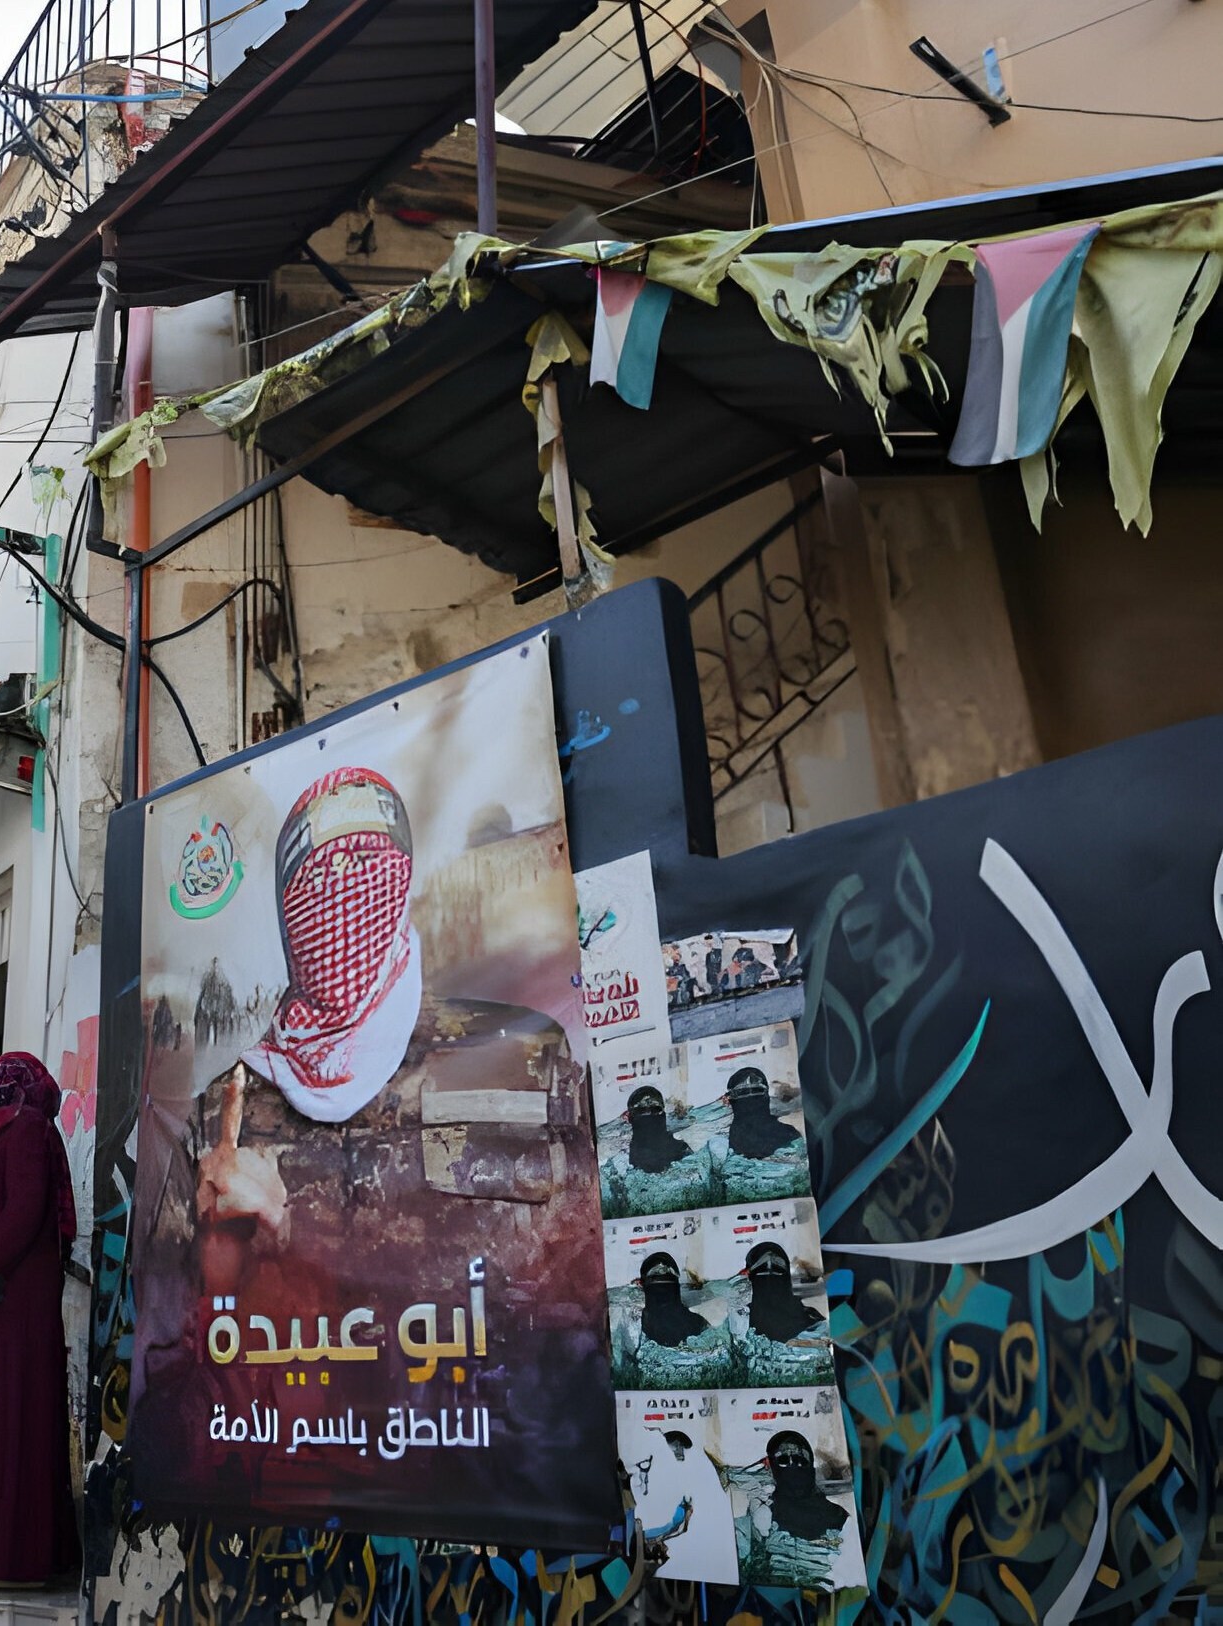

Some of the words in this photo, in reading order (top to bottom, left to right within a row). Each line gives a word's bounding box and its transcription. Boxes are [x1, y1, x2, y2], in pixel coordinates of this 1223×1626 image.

[208, 1295, 378, 1386] عبيدة
[398, 1257, 487, 1384] أبو
[209, 1398, 278, 1445] الأمة
[286, 1407, 367, 1456] باسم
[378, 1405, 490, 1460] الناطق
